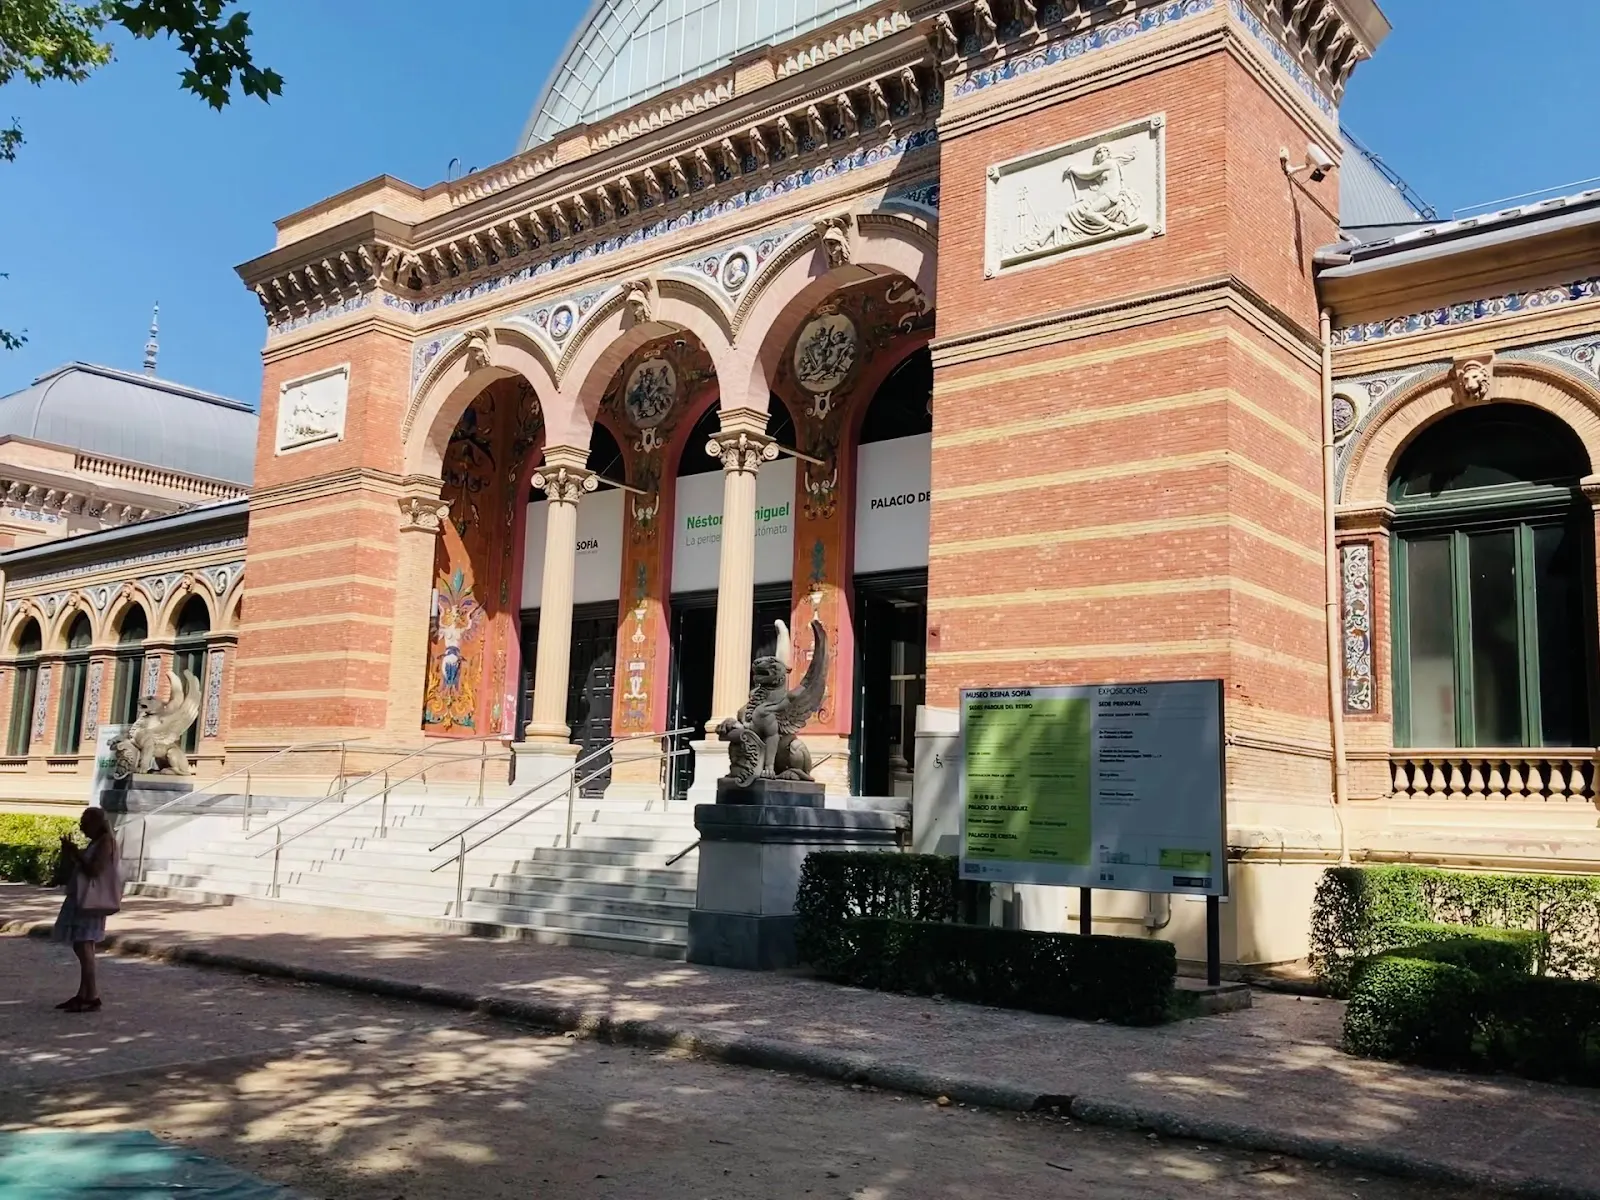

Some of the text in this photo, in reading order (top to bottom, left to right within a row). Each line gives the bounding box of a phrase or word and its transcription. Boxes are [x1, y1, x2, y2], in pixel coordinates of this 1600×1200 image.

[871, 491, 931, 509] PALACIO DE
[687, 514, 724, 530] Néstor
[685, 533, 720, 547] La peripe
[965, 691, 989, 699] MUSEO
[989, 690, 1010, 698] REINA
[1098, 686, 1148, 695] EXPOSICIONES
